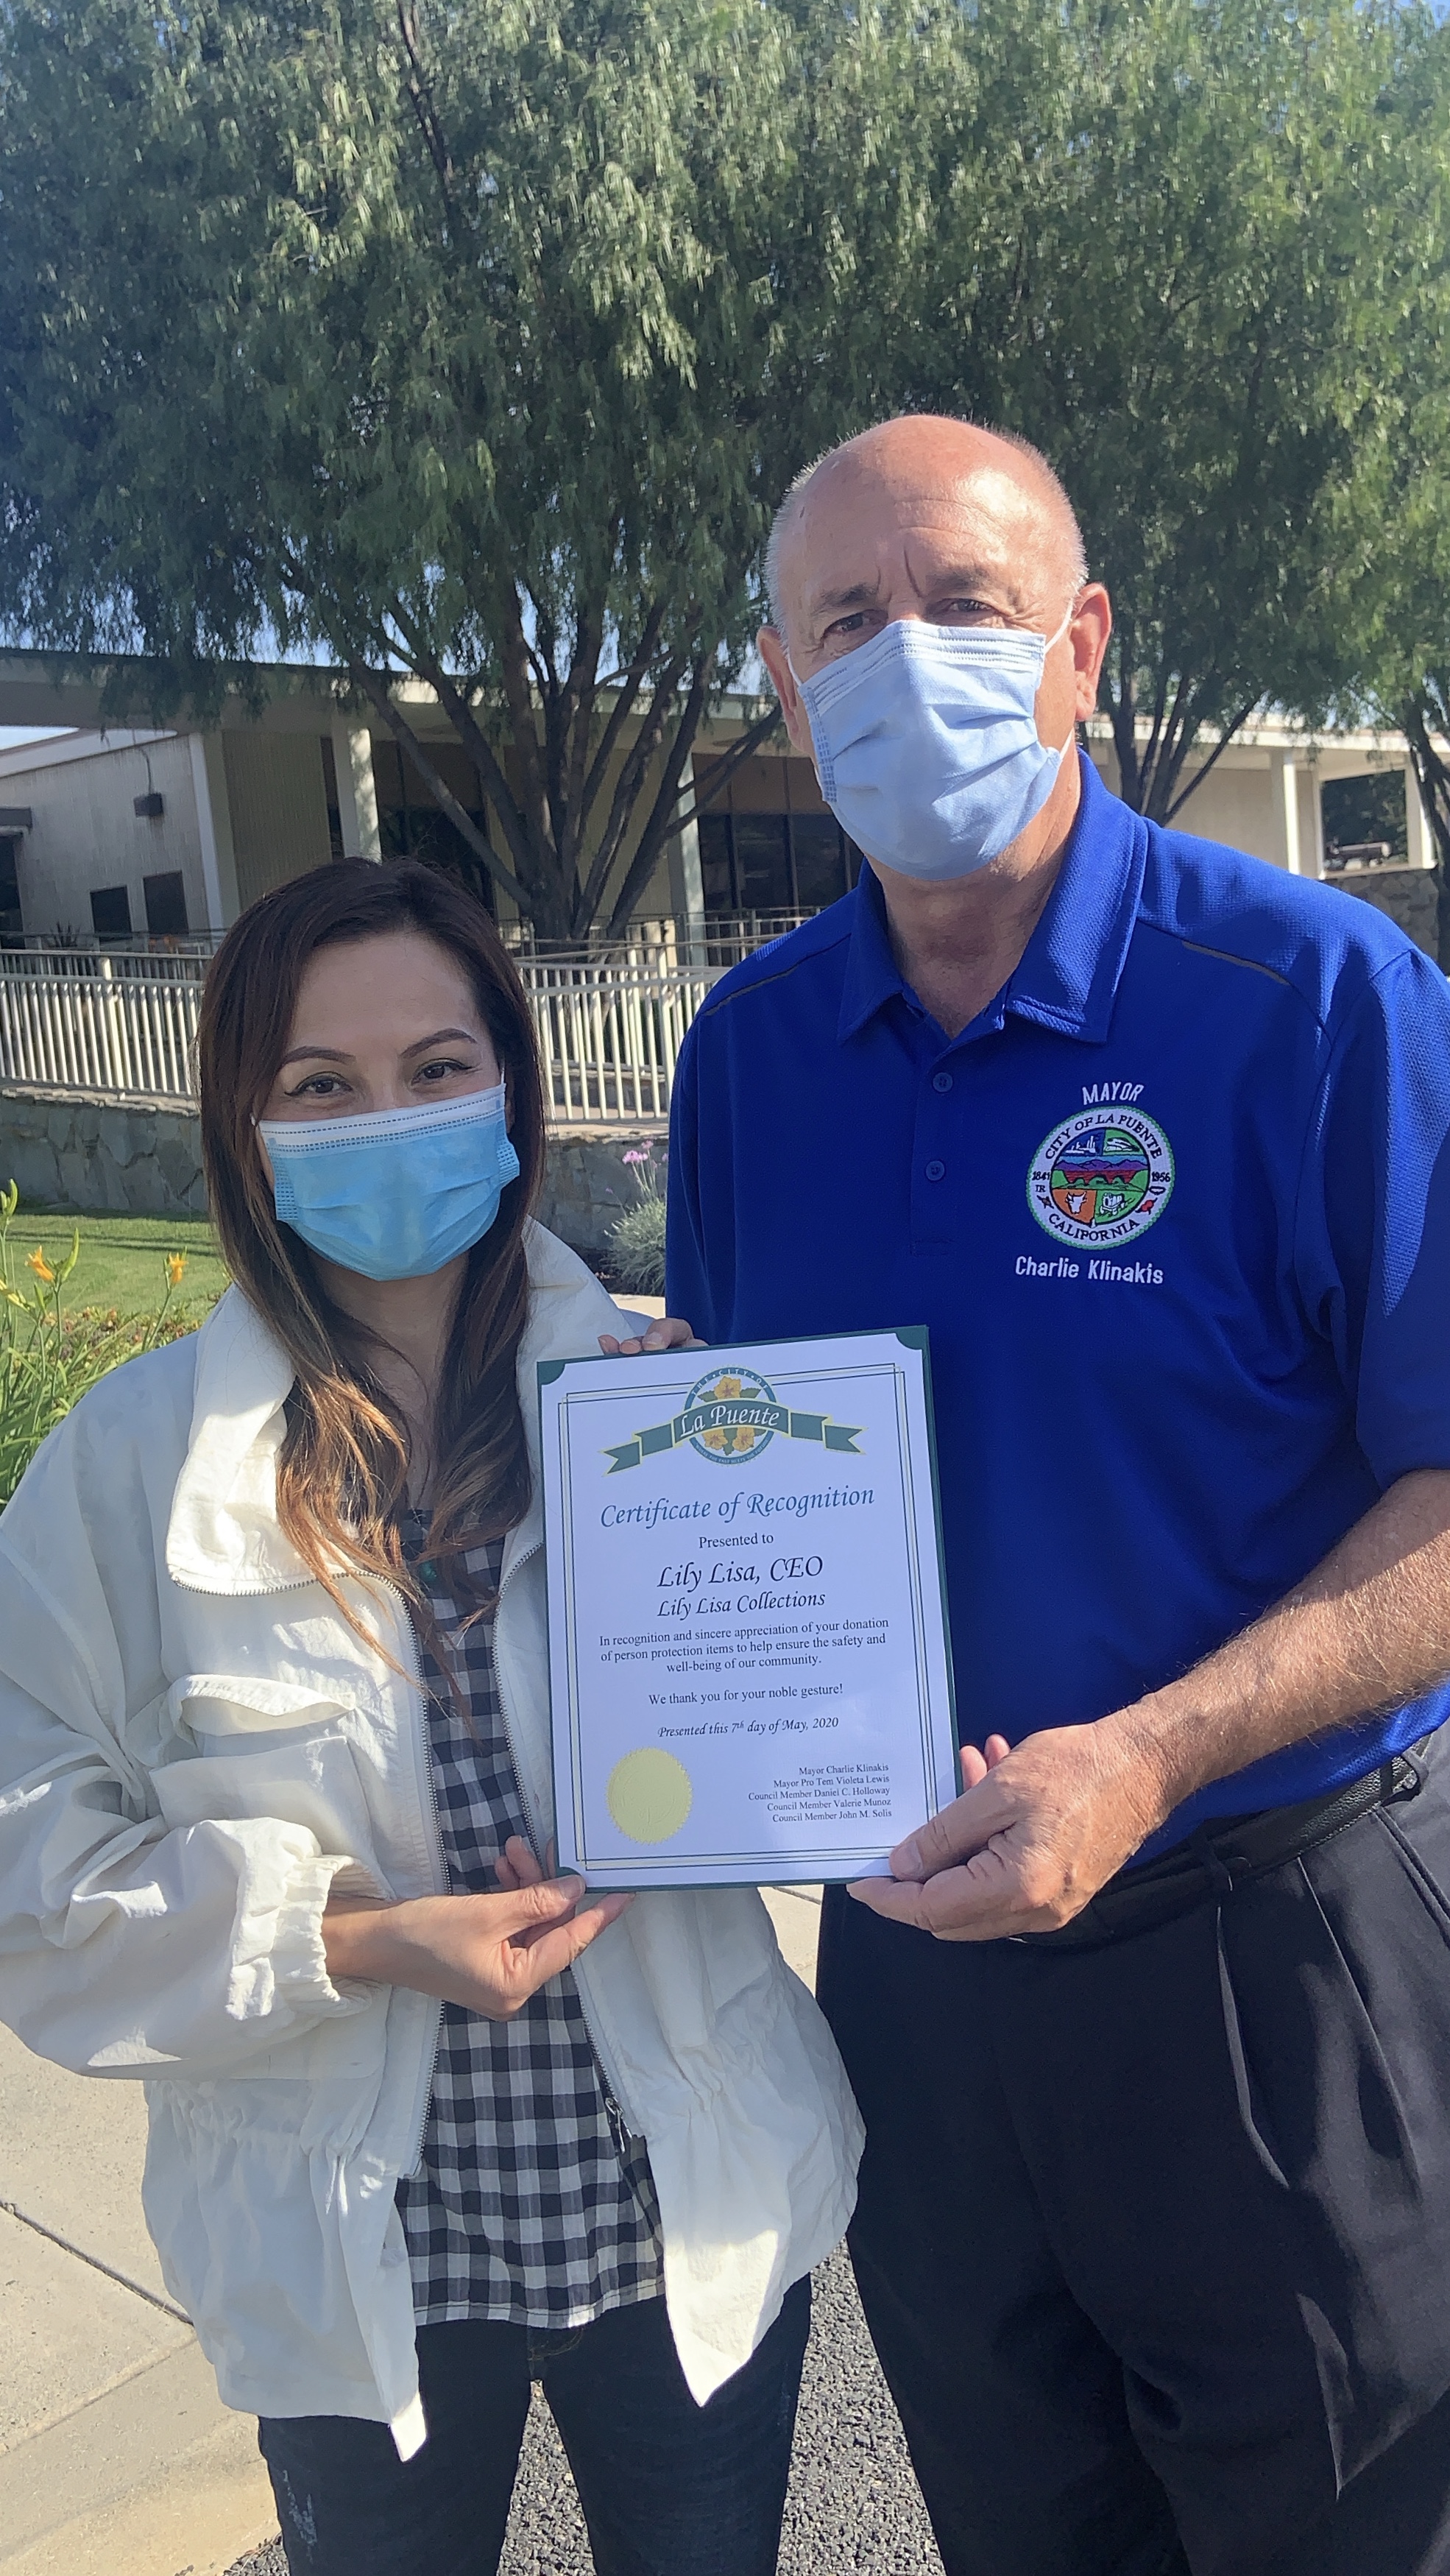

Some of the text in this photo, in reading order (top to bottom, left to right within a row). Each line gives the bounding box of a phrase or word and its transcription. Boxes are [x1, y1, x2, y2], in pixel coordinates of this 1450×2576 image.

[1082, 1081, 1144, 1105] MAYOR
[1045, 1114, 1162, 1160] CITY OF LA PUENTE
[1151, 1172, 1170, 1182] 1956
[1049, 1215, 1139, 1241] CALIFORNIA
[1016, 1256, 1164, 1284] Charlie Klinakis
[757, 1378, 768, 1388] OF
[680, 1405, 779, 1438] La Puente
[601, 1485, 874, 1529] Certificate of Recognition
[699, 1533, 774, 1548] Presented to
[657, 1556, 822, 1592] Lily Lisa, CEO
[657, 1591, 825, 1620] Lily Lisa Collections
[600, 1617, 888, 1646] In recognition and sincere appreciation of your donation
[601, 1633, 885, 1663] of person protection items to help ensure the safety and
[667, 1659, 721, 1672] well-being
[724, 1658, 737, 1668] of
[759, 1653, 821, 1667] community.
[649, 1684, 843, 1704] We thank you for your noble gesture!
[658, 1723, 708, 1737] Presented
[710, 1722, 728, 1734] this
[748, 1721, 765, 1735] day
[769, 1719, 782, 1735] of
[782, 1720, 808, 1732] May,
[813, 1718, 838, 1728] 2020
[799, 1763, 888, 1776] Mayor Charlie Klinakis
[774, 1780, 799, 1789] Mayor
[836, 1776, 864, 1785] Violeta
[866, 1774, 889, 1783] Lewis
[749, 1791, 778, 1800] Council
[780, 1790, 812, 1799] Member
[814, 1788, 839, 1797] Daniel
[853, 1787, 890, 1796] Holloway
[768, 1802, 797, 1811] Council
[799, 1801, 832, 1809] Member
[773, 1813, 802, 1822] Council
[805, 1812, 837, 1821] Member
[839, 1811, 857, 1819] John
[872, 1809, 891, 1817] Solis
